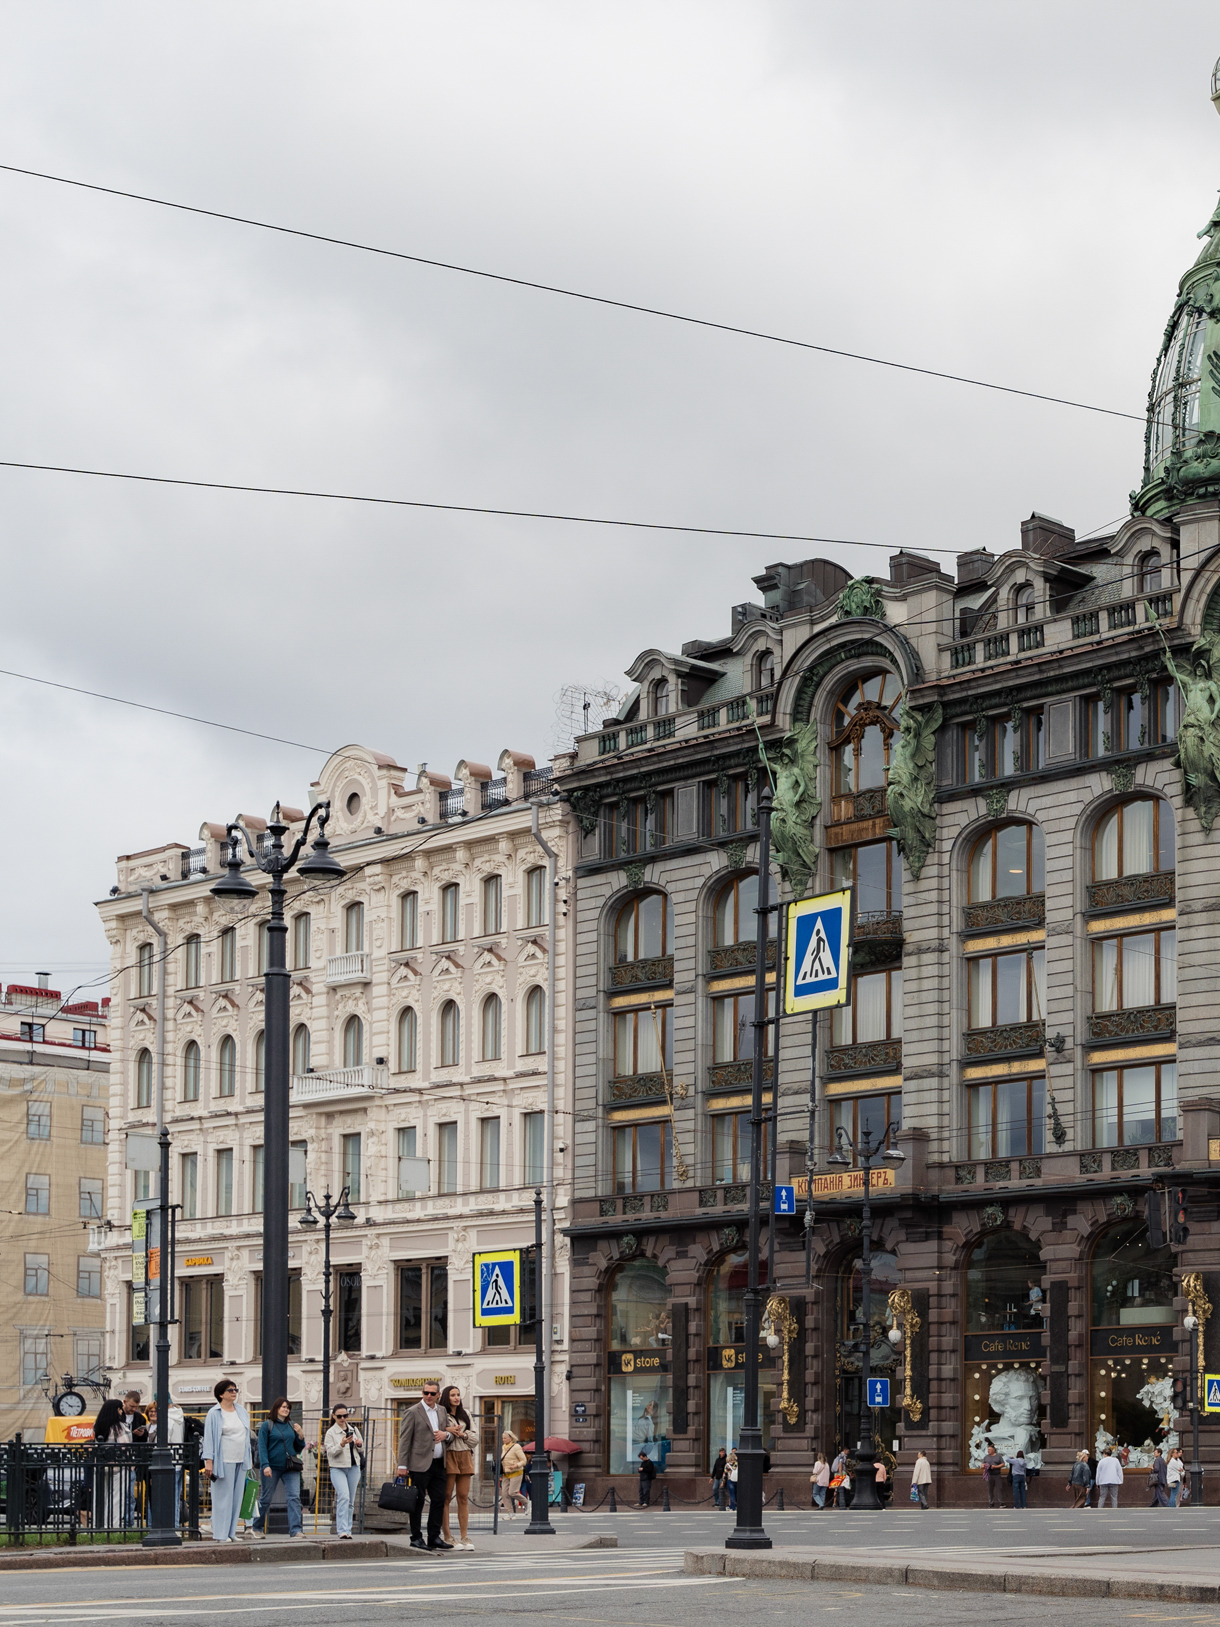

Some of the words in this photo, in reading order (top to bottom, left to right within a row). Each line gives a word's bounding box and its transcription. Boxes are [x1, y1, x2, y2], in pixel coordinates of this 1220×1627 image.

[847, 1171, 892, 1189] ЗИНЕРЪ.
[184, 1257, 212, 1266] БАРВИХА
[981, 1340, 1004, 1352] Cafe
[1006, 1337, 1031, 1351] René
[1108, 1334, 1133, 1347] Cafe
[1135, 1331, 1162, 1346] René
[636, 1356, 660, 1367] store
[737, 1352, 763, 1364] ste
